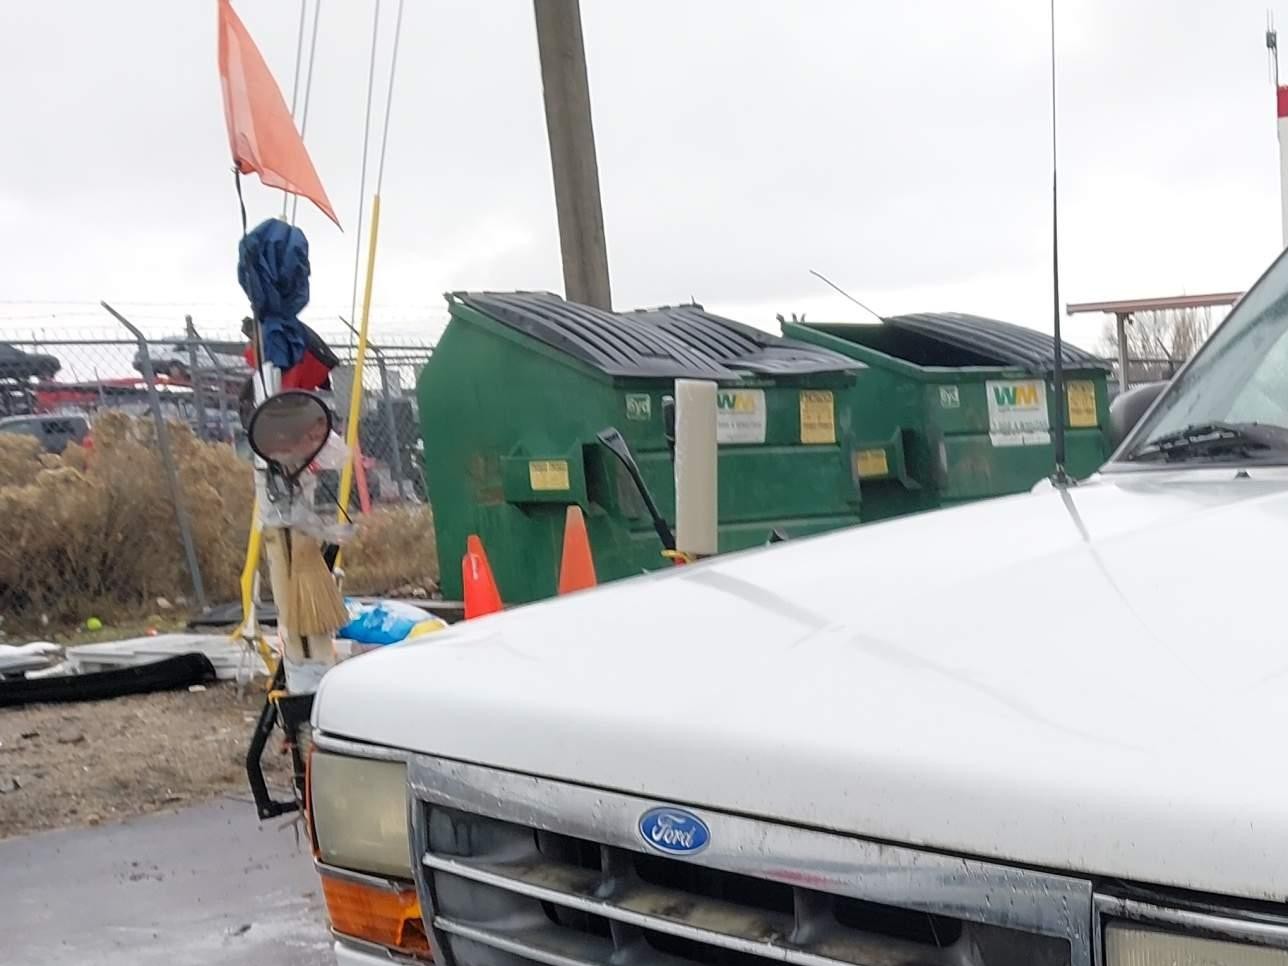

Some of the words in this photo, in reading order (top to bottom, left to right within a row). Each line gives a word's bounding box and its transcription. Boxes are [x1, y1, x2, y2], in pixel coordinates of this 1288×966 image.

[717, 393, 758, 412] WM
[992, 383, 1040, 407] WM
[651, 813, 697, 849] Ford
